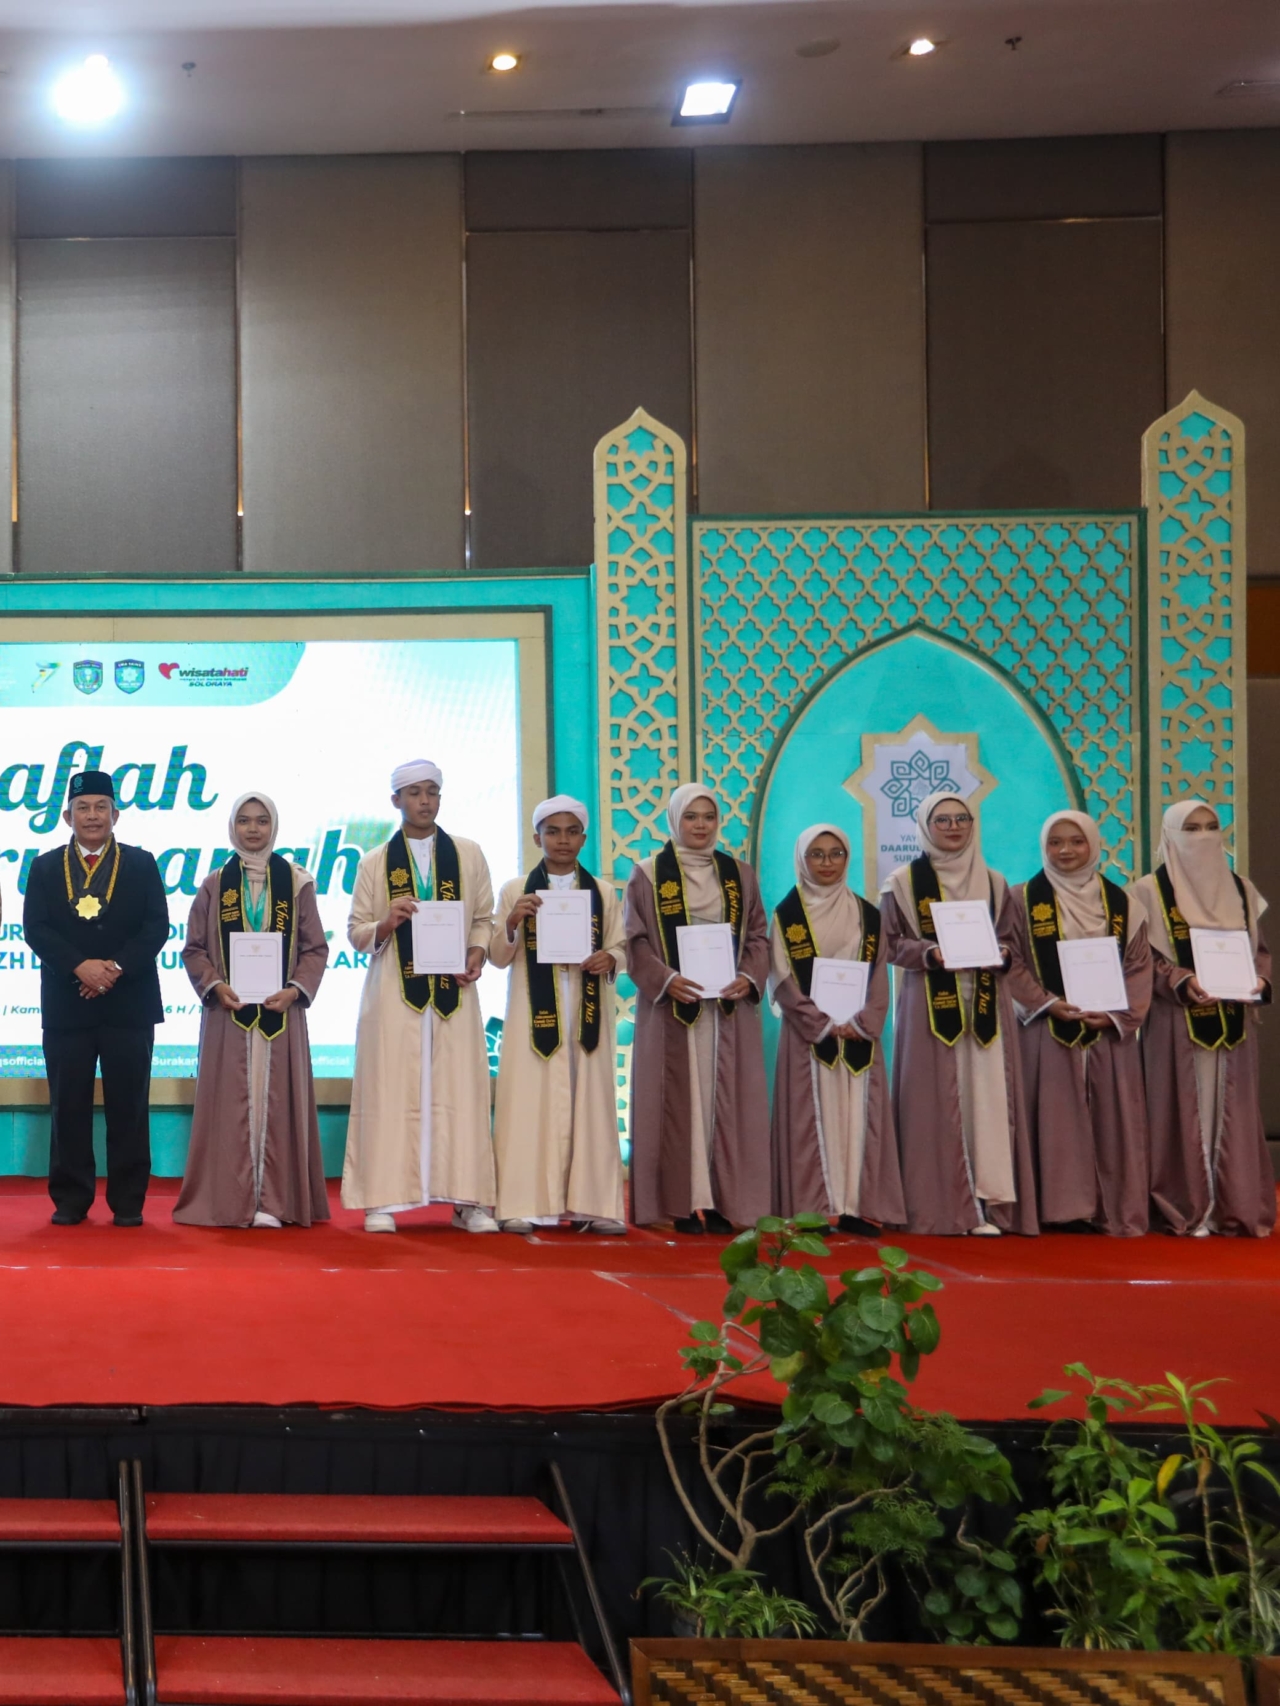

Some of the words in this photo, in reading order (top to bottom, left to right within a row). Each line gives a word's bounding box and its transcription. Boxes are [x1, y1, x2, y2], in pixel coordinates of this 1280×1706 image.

[179, 667, 249, 677] wisatahati
[900, 834, 918, 842] YAY
[11, 1005, 40, 1014] Kam
[585, 999, 596, 1025] Juz
[312, 1056, 350, 1066] official
